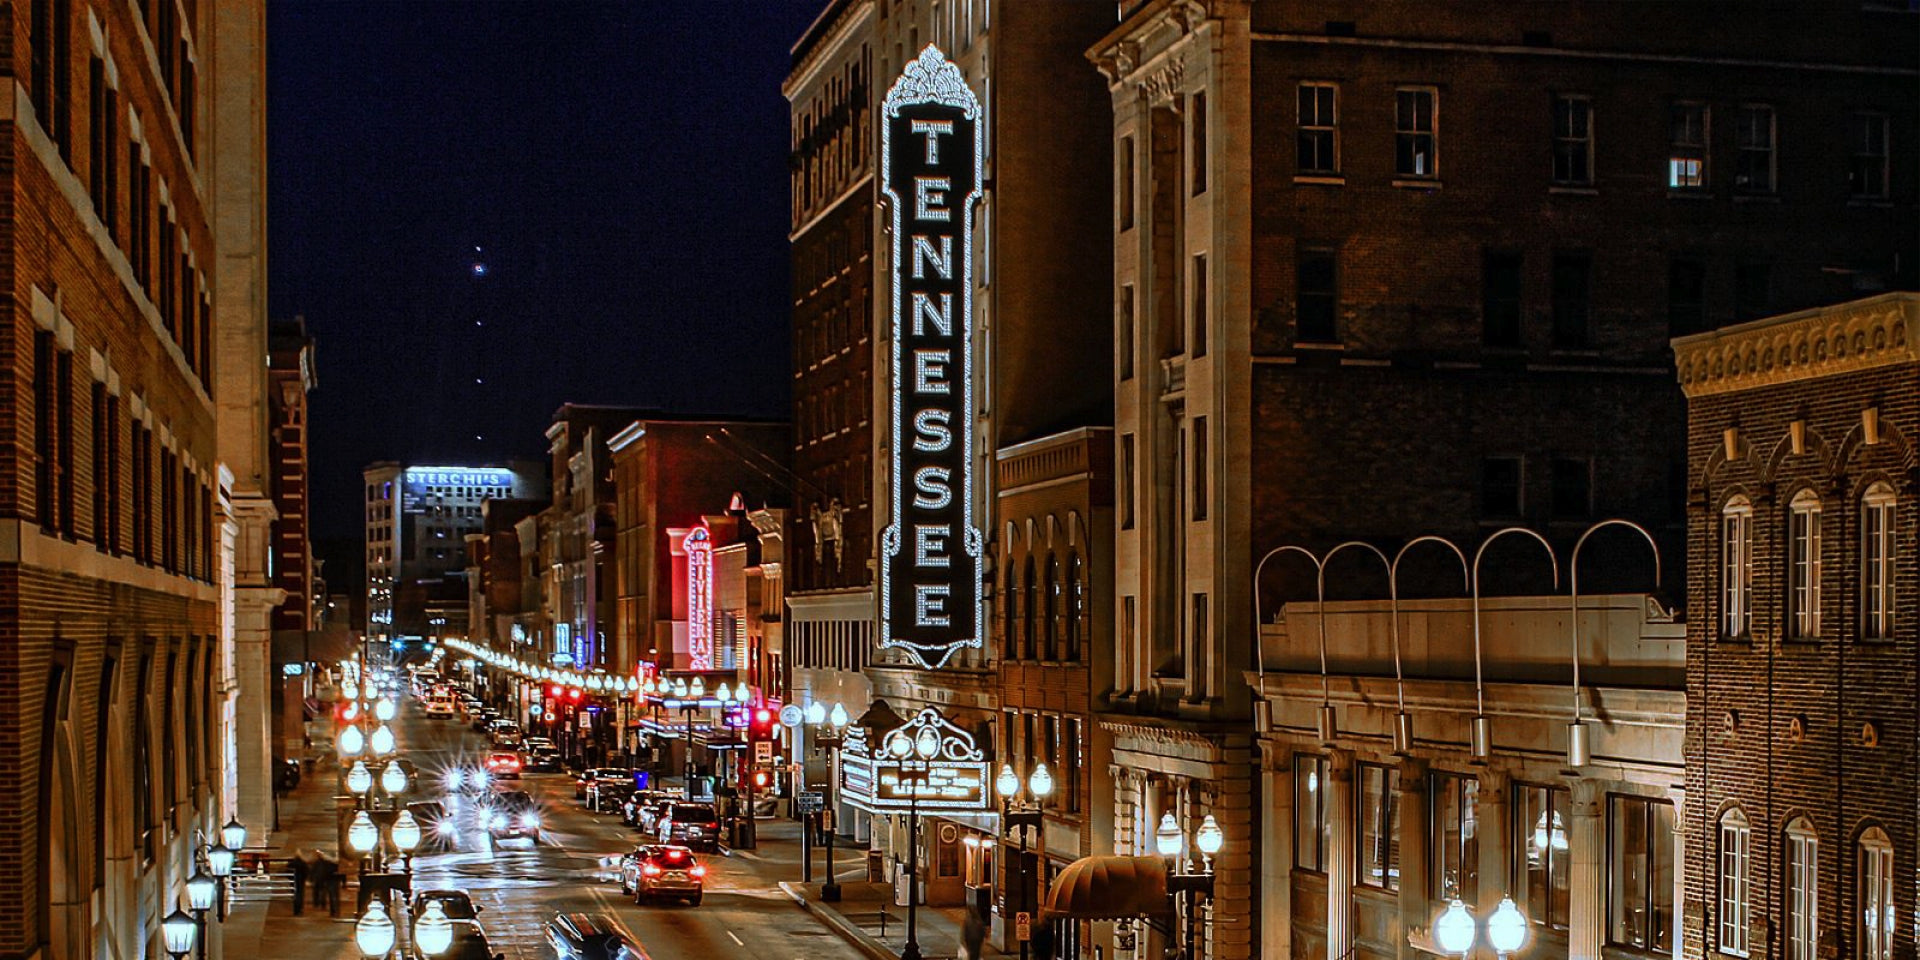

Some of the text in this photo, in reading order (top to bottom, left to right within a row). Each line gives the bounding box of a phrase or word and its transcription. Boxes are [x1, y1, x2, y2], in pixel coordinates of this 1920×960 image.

[911, 118, 954, 628] TENNESSEE
[406, 473, 499, 484] STERCHI'S
[696, 551, 706, 654] RIVIERA
